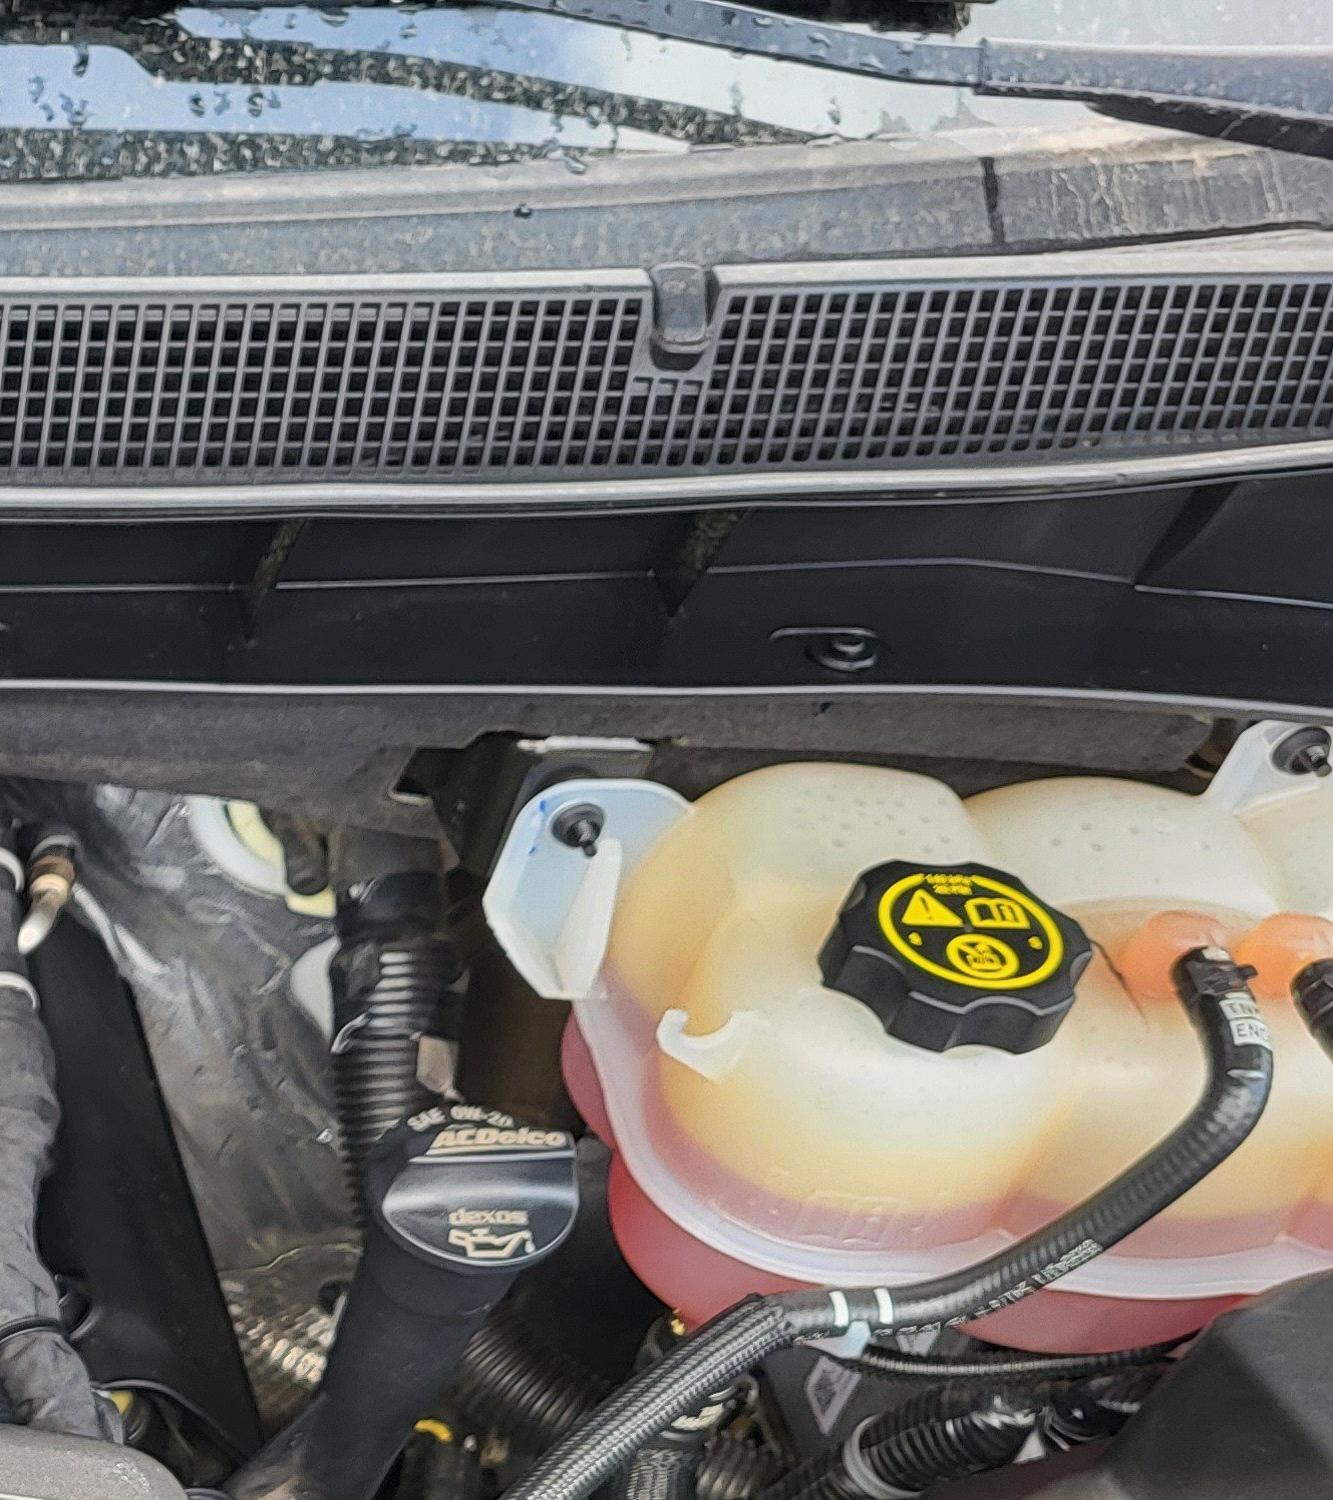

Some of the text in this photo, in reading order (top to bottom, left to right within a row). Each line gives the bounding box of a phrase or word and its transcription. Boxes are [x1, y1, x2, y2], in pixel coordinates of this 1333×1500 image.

[407, 1104, 515, 1132] SAE 0W-20
[430, 1127, 567, 1147] ACDelco
[448, 1207, 530, 1227] dexos
